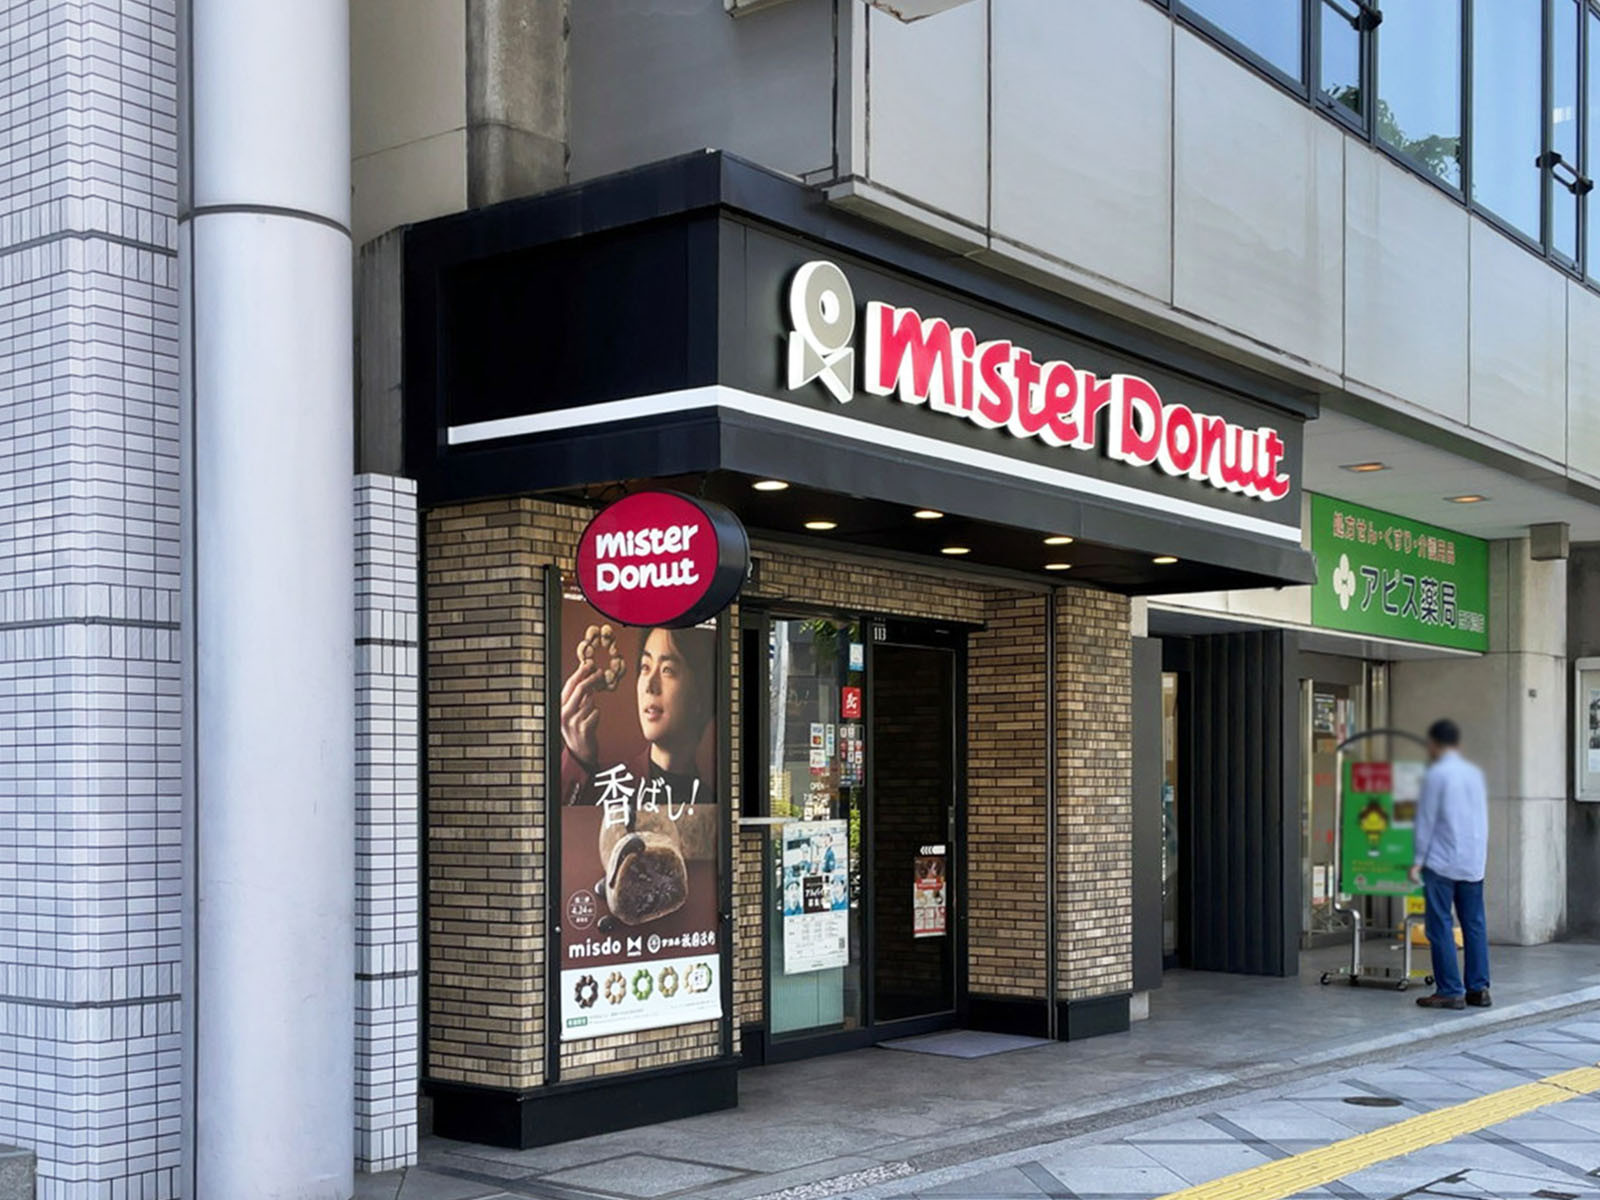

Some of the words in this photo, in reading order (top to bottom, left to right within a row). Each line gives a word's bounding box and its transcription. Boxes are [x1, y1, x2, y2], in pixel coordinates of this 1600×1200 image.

[1108, 373, 1290, 502] Donut
[596, 558, 699, 592] Donut
[1360, 565, 1458, 629] アピス薬局
[568, 936, 622, 959] misdo
